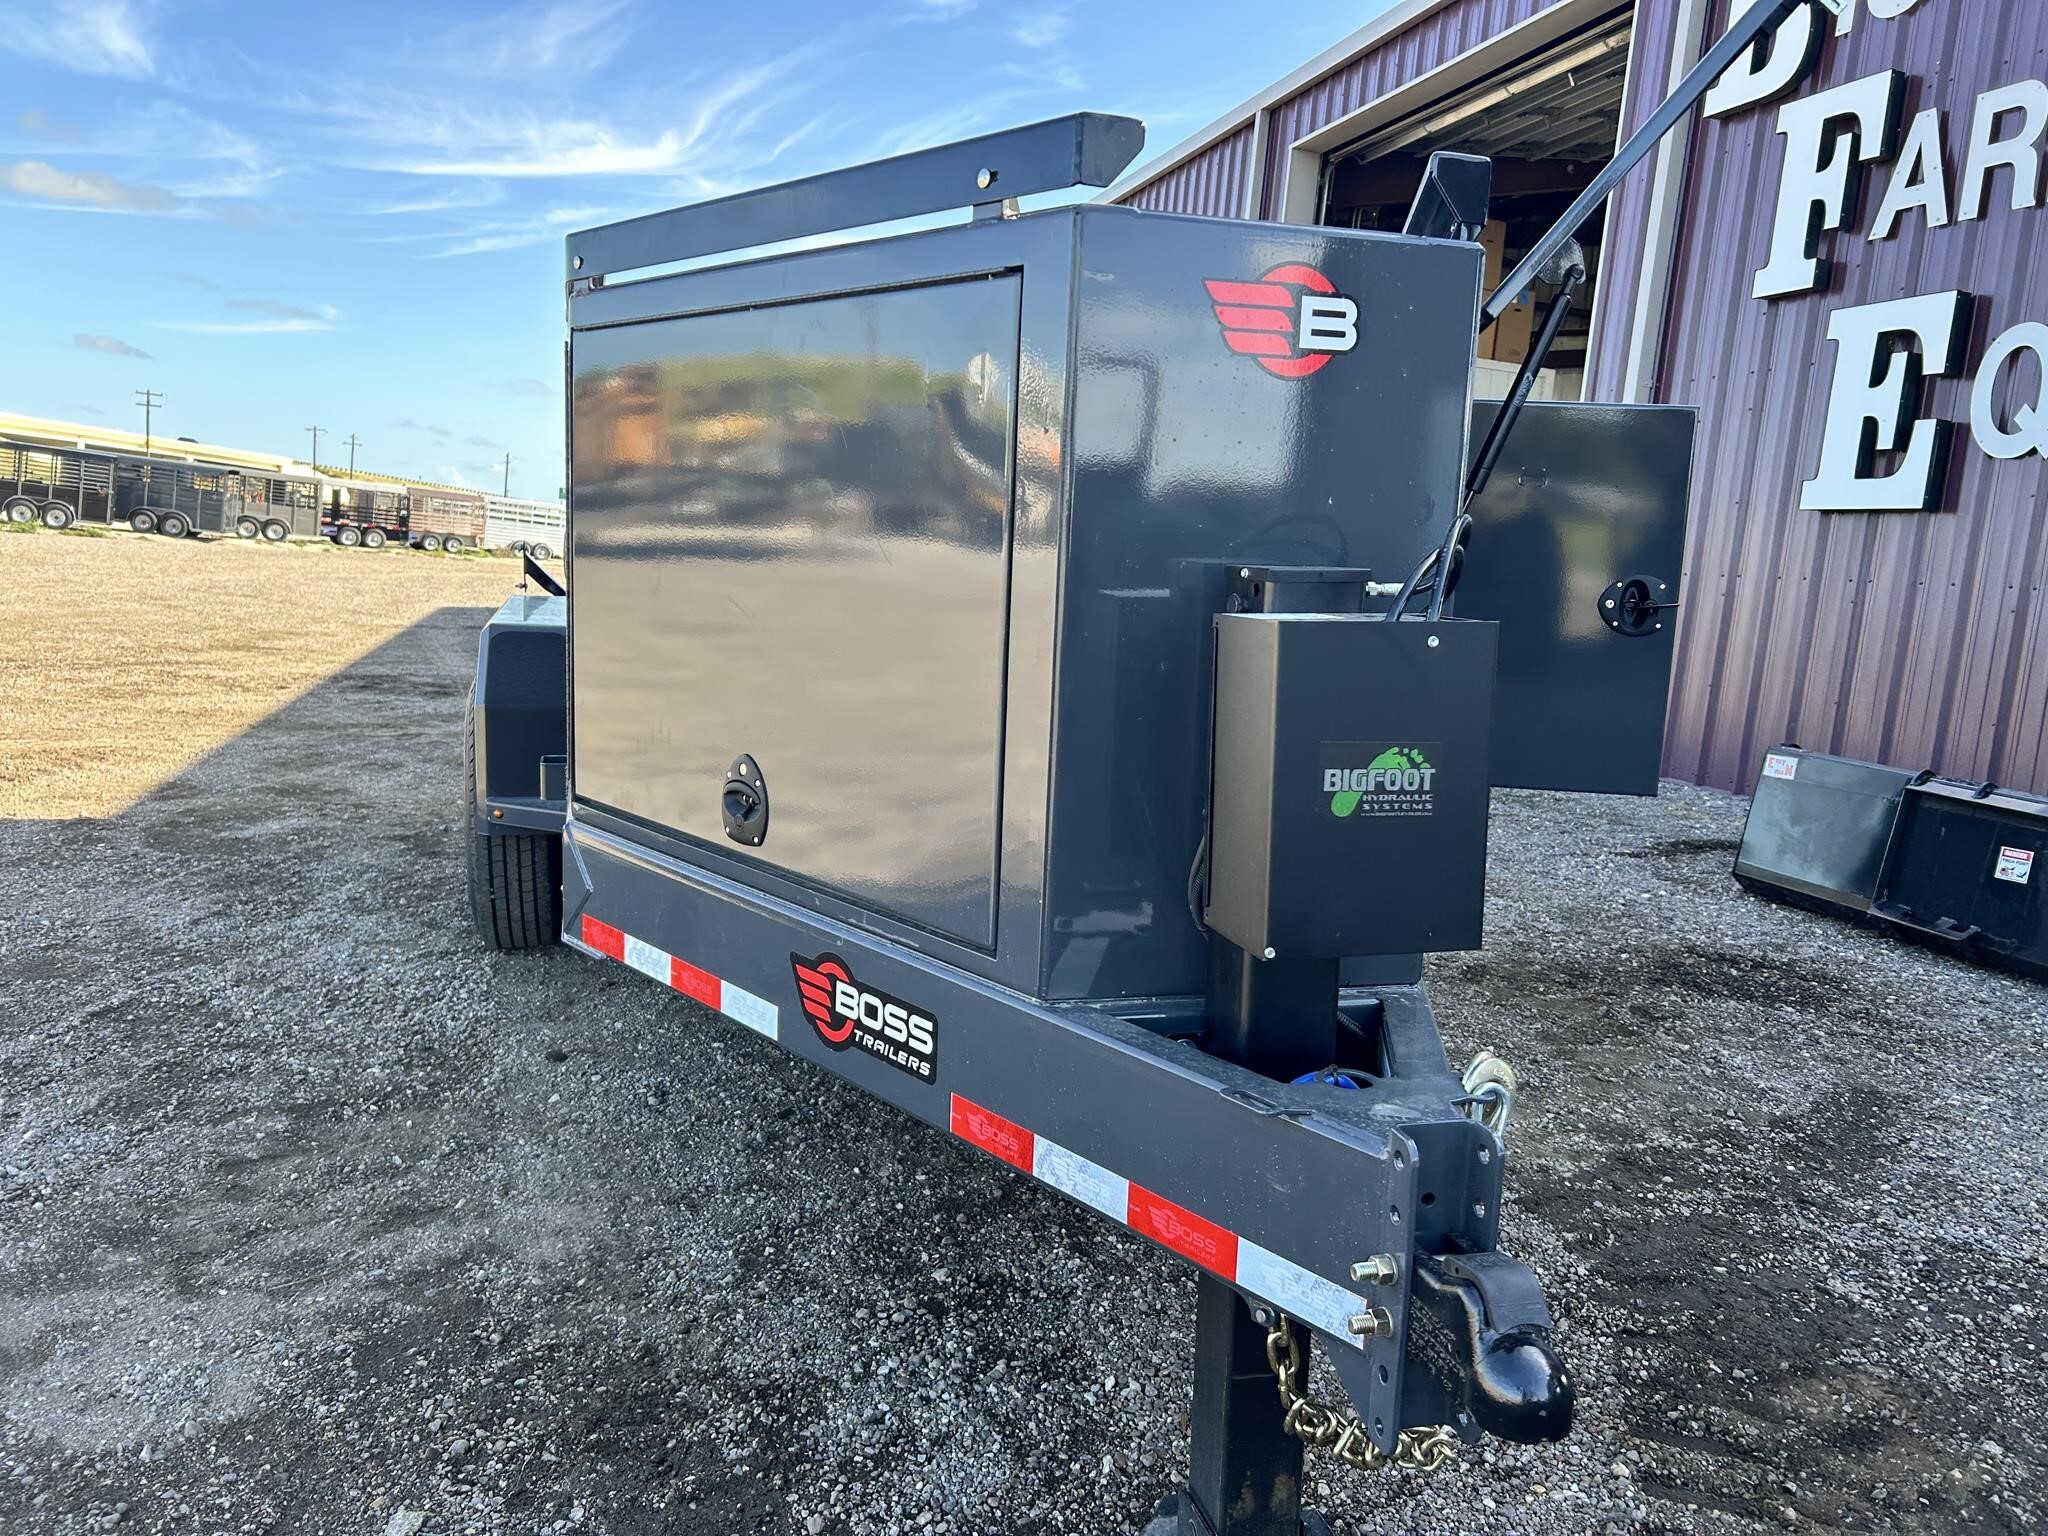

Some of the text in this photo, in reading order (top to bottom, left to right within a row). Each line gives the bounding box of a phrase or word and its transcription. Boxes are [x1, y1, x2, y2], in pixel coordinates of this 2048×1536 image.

[1752, 68, 2048, 300] FAR
[1299, 295, 1358, 351] B
[1323, 768, 1436, 792] BIGFOOT
[835, 980, 934, 1055] BOSS
[854, 1030, 931, 1076] TRAILERS
[981, 1123, 1018, 1151] BOSS
[1168, 1221, 1217, 1255] BOSS
